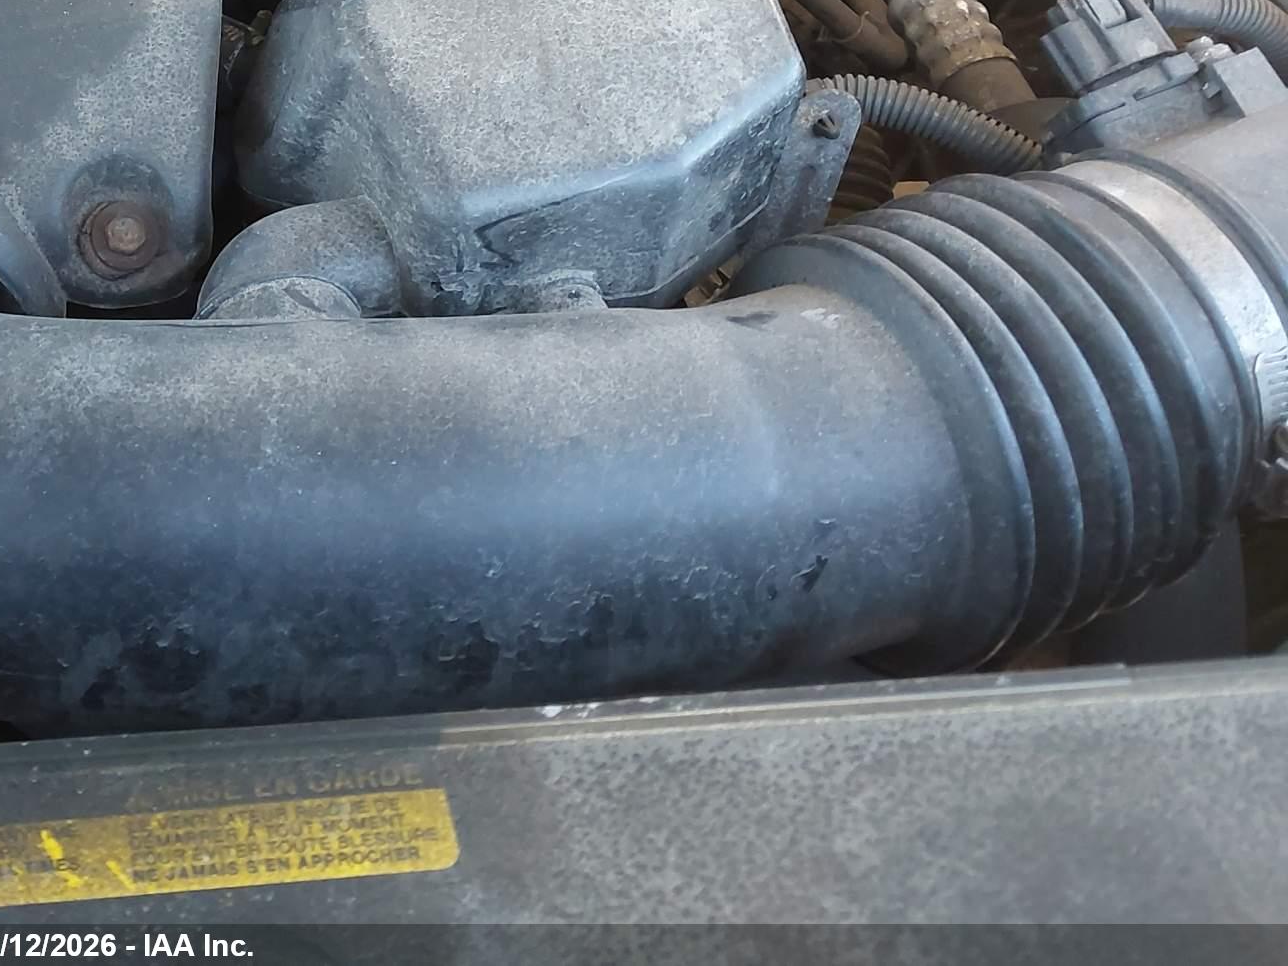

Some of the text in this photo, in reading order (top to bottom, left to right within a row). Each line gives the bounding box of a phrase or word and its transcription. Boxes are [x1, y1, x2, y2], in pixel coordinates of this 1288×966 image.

[266, 836, 331, 856] TOUTE
[164, 861, 238, 881] JAMAIS
[297, 846, 421, 871] APPROCHER
